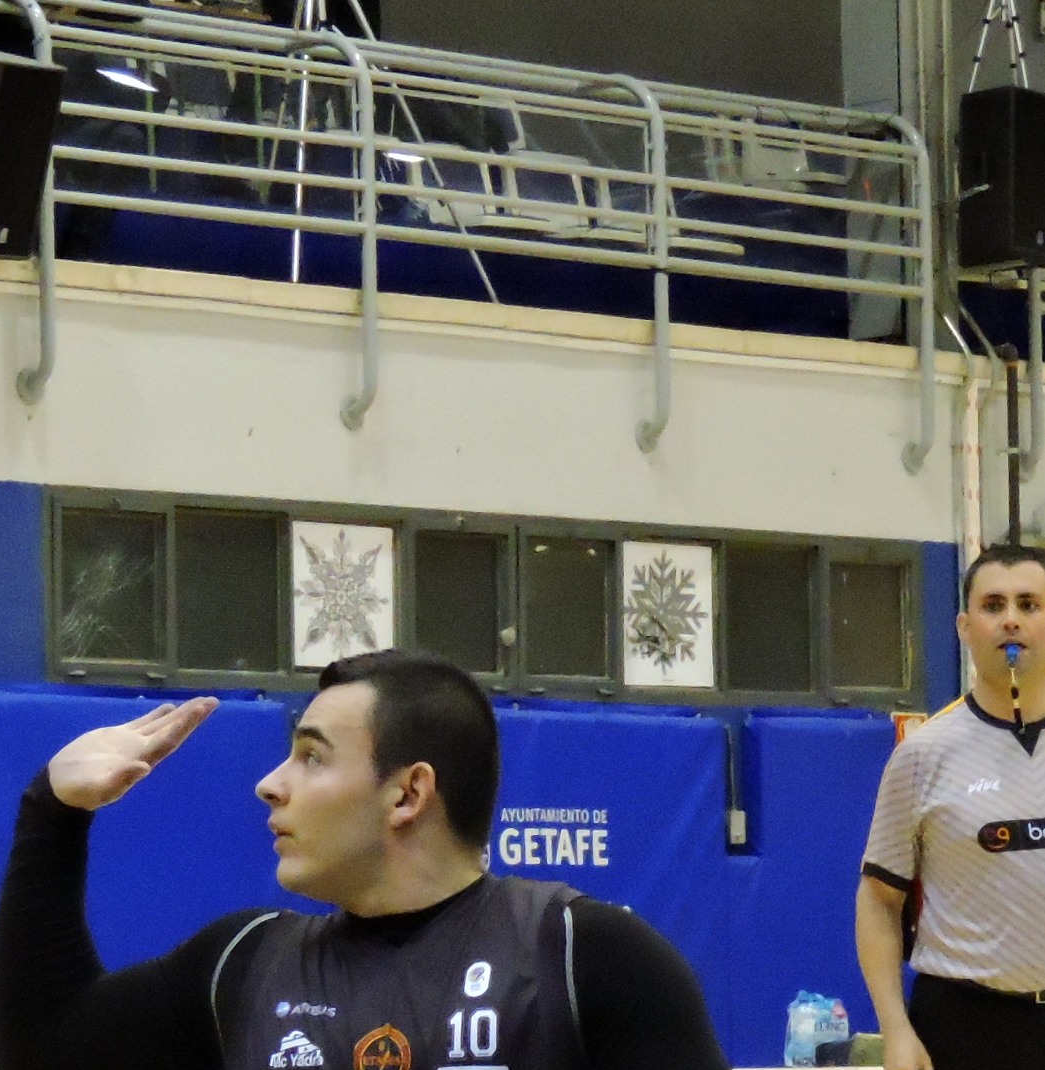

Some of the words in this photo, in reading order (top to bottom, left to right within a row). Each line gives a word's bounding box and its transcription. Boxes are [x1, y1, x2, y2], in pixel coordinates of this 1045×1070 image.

[501, 808, 589, 823] AYUNTAMIENTO
[593, 809, 608, 824] DE
[499, 828, 609, 866] GETAFE
[448, 1007, 499, 1059] 10
